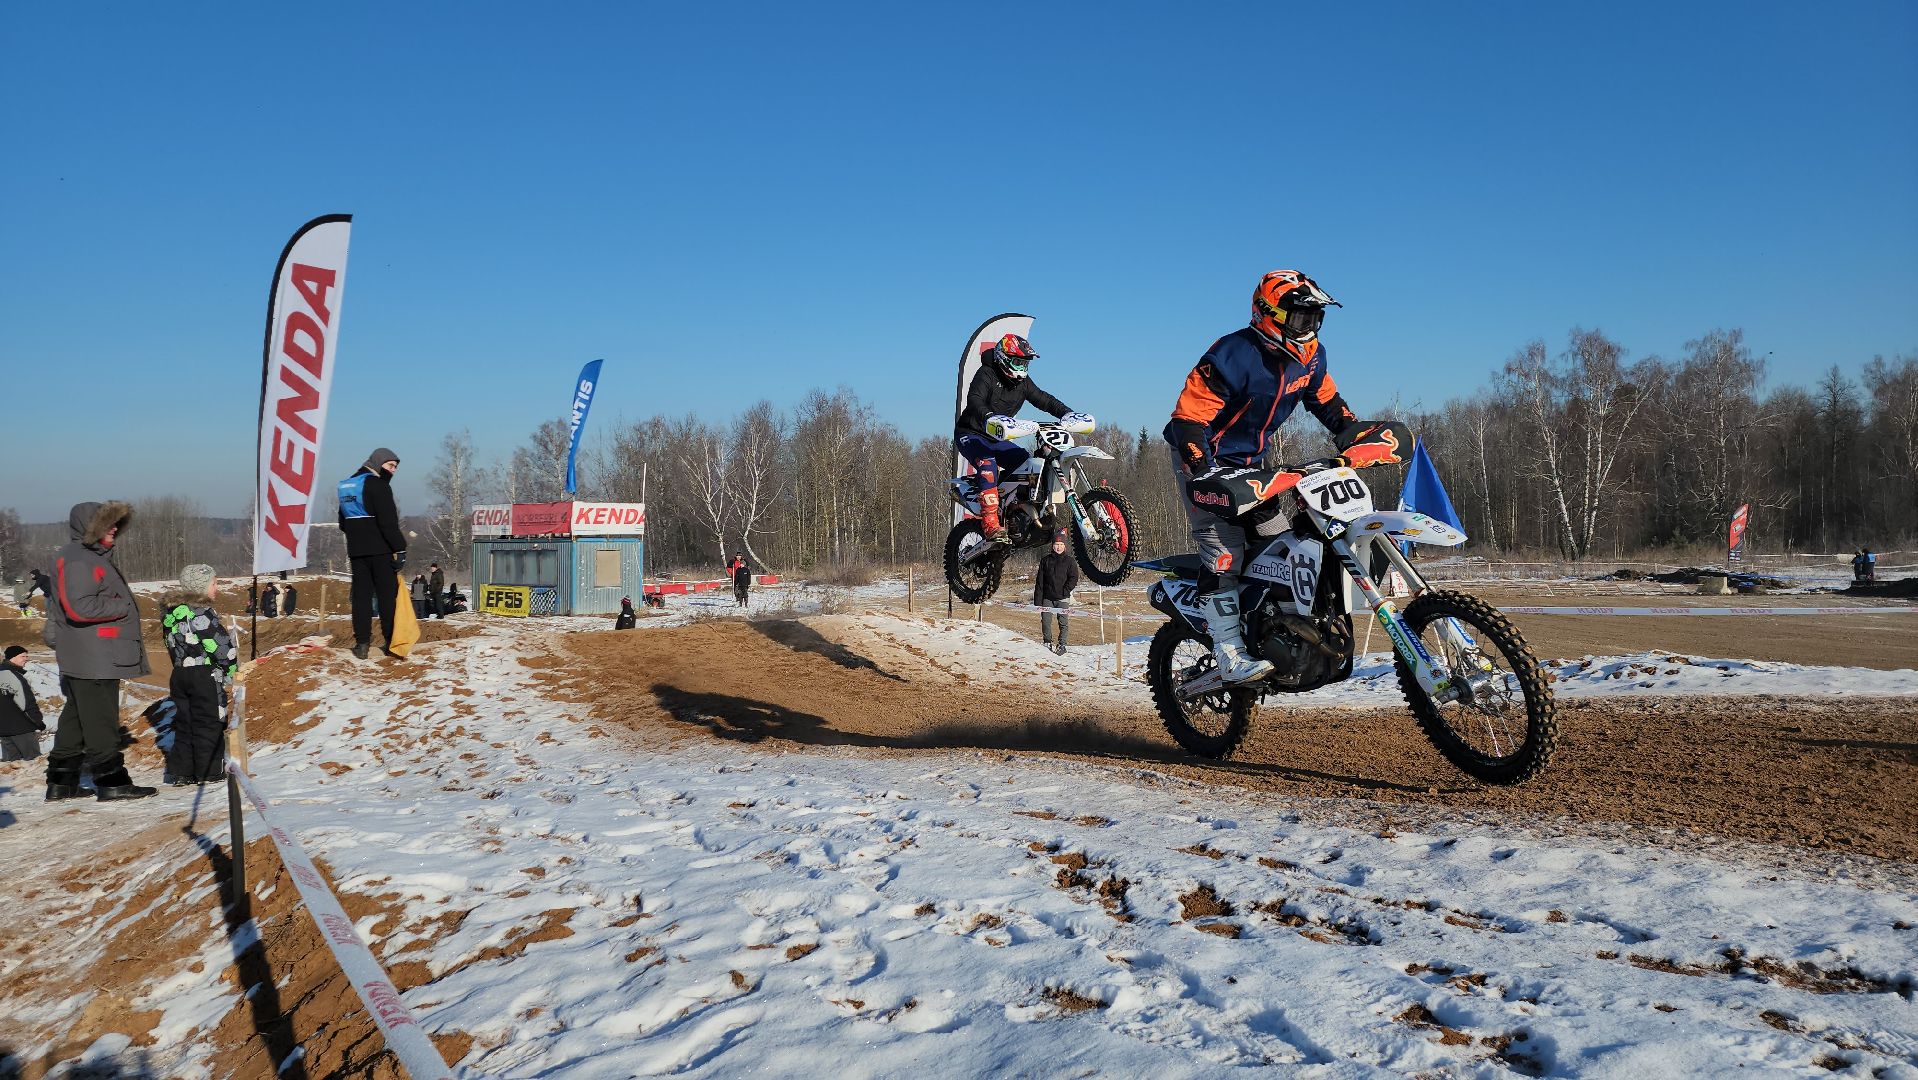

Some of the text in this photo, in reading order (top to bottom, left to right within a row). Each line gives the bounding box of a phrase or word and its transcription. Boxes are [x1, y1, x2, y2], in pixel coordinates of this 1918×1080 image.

[264, 263, 336, 558] KENDA
[569, 379, 593, 449] ANTIS
[1046, 431, 1069, 446] 27
[1310, 478, 1366, 511] 700
[1252, 564, 1270, 576] TEAM
[1386, 623, 1416, 665] MOTOREX
